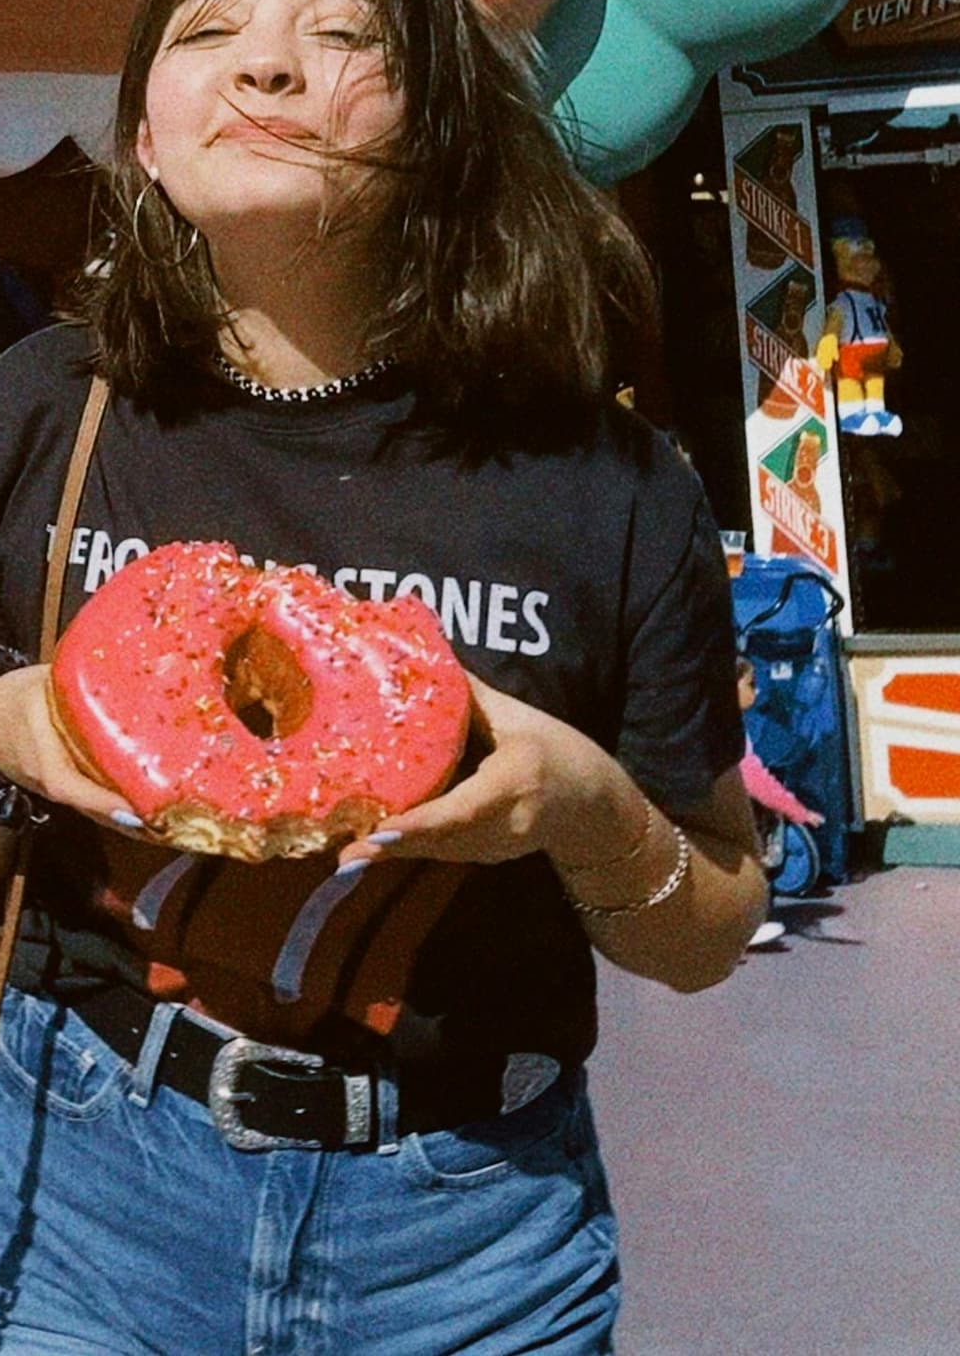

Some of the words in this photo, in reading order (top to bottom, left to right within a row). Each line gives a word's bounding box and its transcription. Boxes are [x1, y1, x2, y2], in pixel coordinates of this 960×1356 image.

[741, 178, 791, 246] STRIKE
[794, 220, 806, 257] 1
[751, 325, 804, 395] STRIKE
[806, 371, 818, 406] 2
[764, 478, 818, 550] STRIKE
[817, 524, 830, 560] 3
[333, 567, 551, 657] STONES
